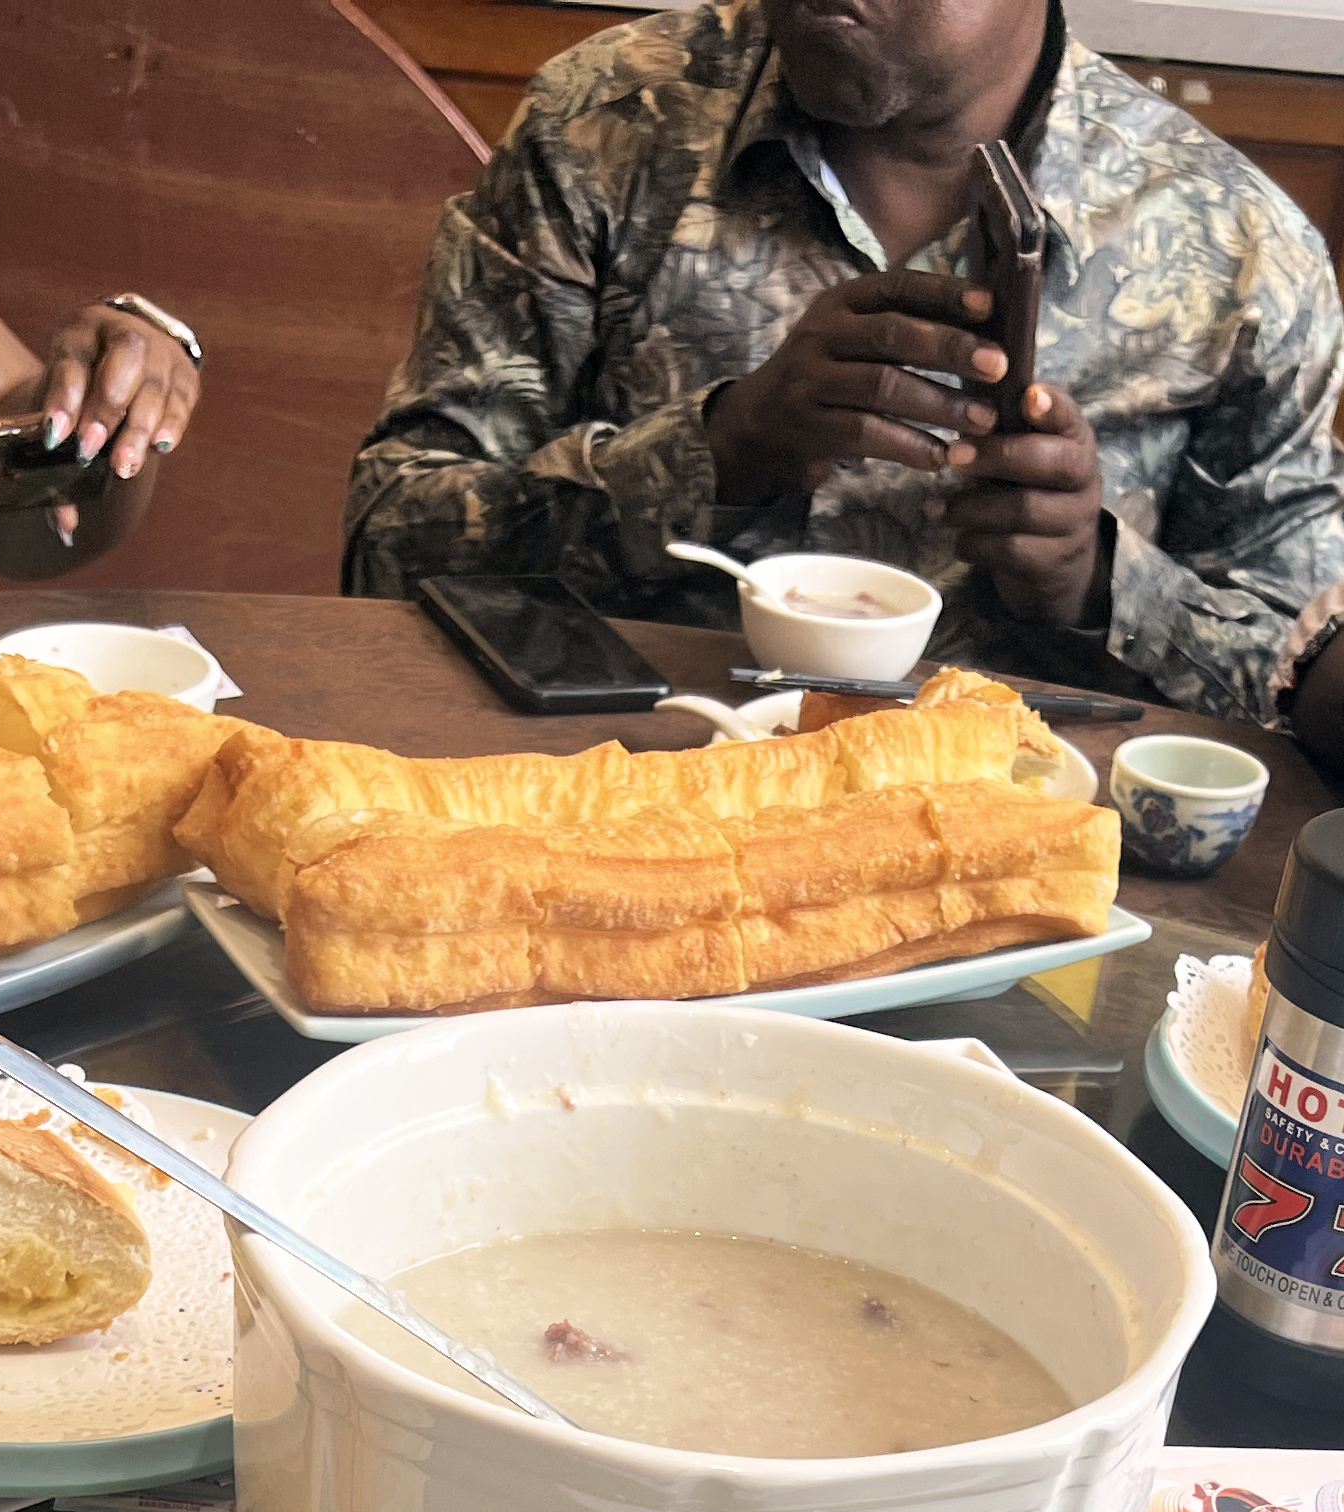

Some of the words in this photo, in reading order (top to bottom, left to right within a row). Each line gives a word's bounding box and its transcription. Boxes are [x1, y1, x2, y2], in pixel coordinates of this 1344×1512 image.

[1265, 1106, 1315, 1143] SAFETY
[1319, 1137, 1330, 1150] &
[1236, 1250, 1276, 1287] TOUCH
[1277, 1276, 1321, 1305] OPEN
[1322, 1291, 1333, 1307] &
